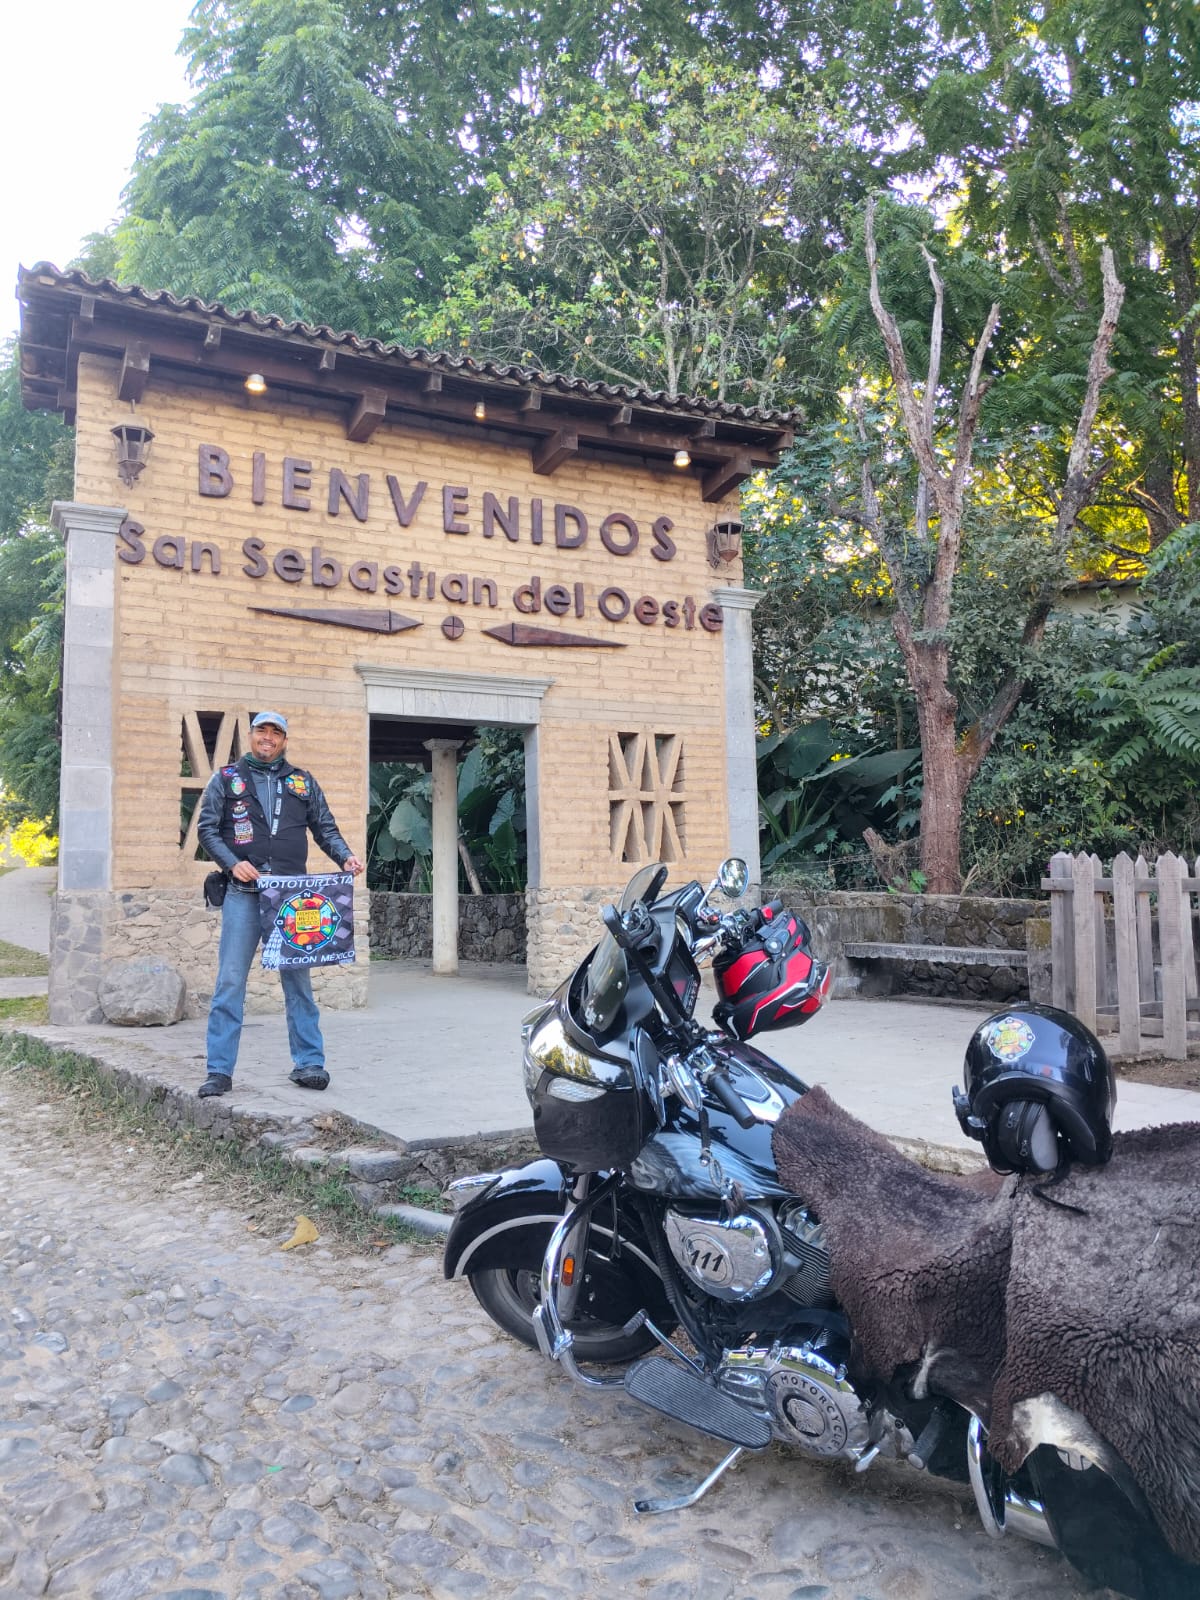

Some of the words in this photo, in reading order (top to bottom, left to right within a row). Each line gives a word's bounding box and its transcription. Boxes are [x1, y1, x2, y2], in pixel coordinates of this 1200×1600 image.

[198, 443, 678, 562] BIENVENIDOS
[118, 520, 221, 573] San
[241, 537, 499, 607] Sebastian
[513, 576, 584, 618] del
[599, 586, 723, 632] Oeste
[257, 875, 353, 889] MOTOTURISTA
[690, 1250, 723, 1272] 111
[781, 1375, 843, 1448] MOTORCYCLE
